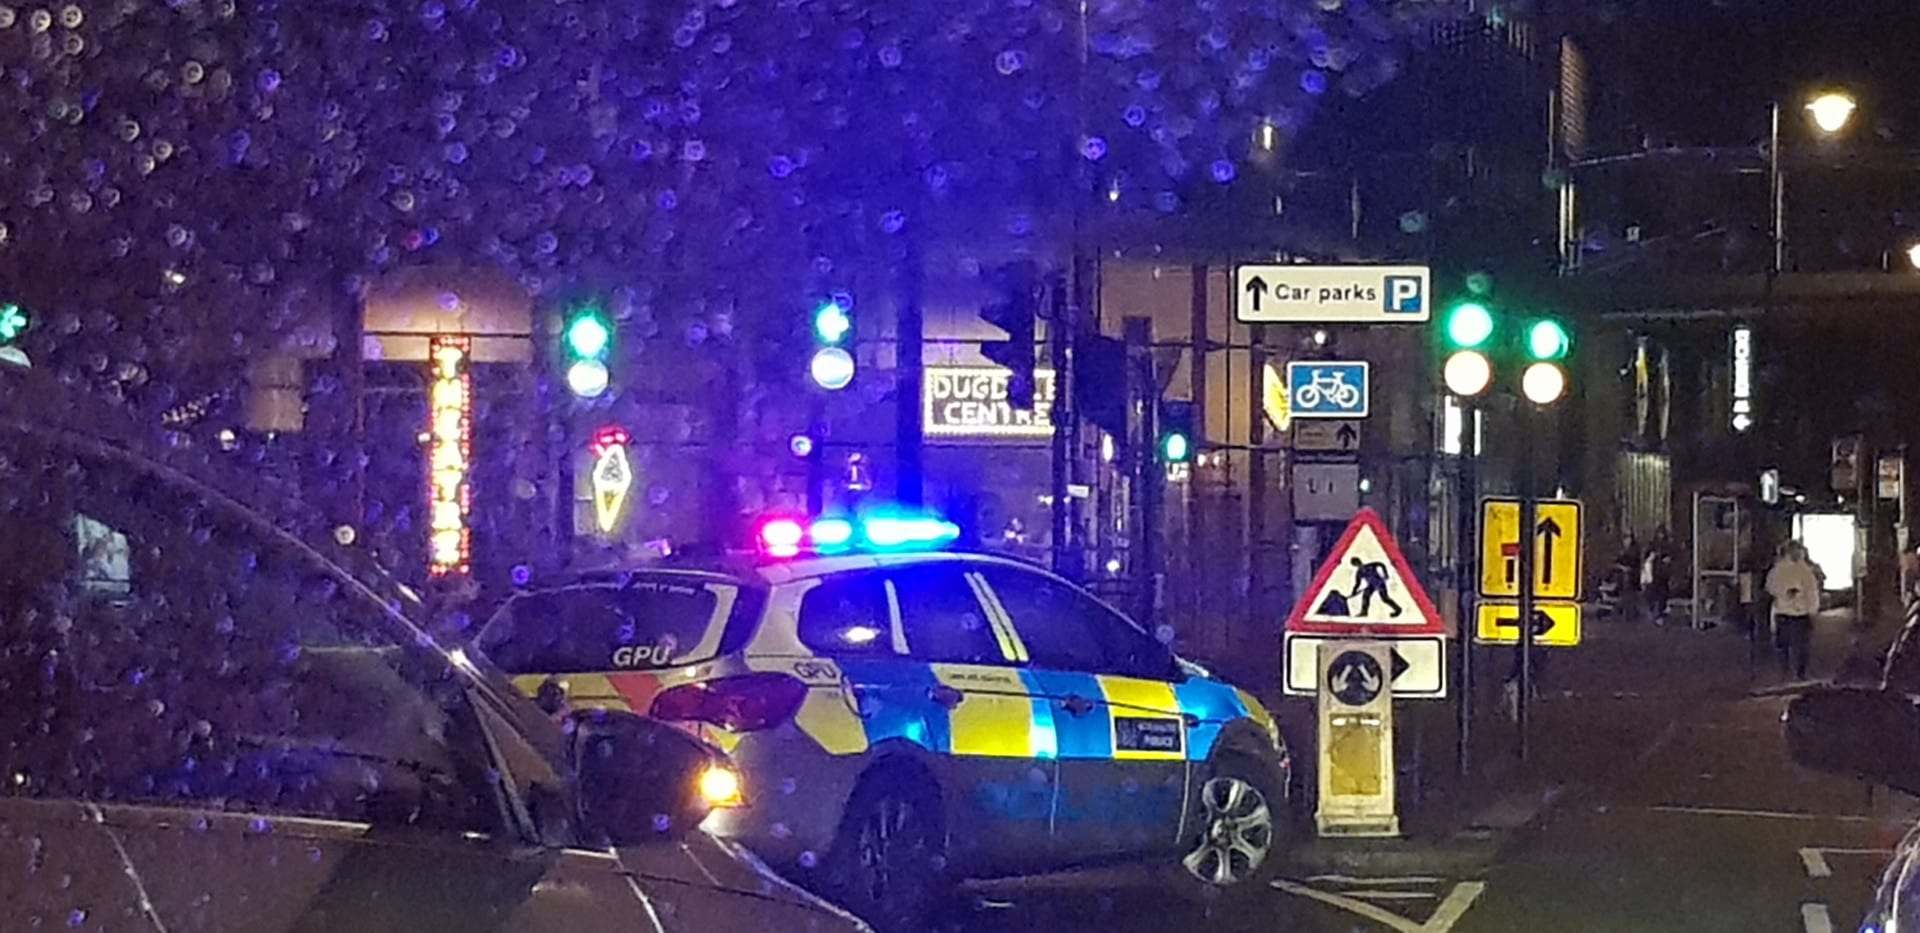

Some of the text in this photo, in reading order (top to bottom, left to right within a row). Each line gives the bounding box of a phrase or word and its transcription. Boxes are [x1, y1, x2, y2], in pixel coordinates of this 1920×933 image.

[1275, 279, 1418, 311] Car parks P
[934, 375, 1056, 400] DUGDE
[612, 646, 671, 667] GPU
[793, 661, 838, 680] GPU
